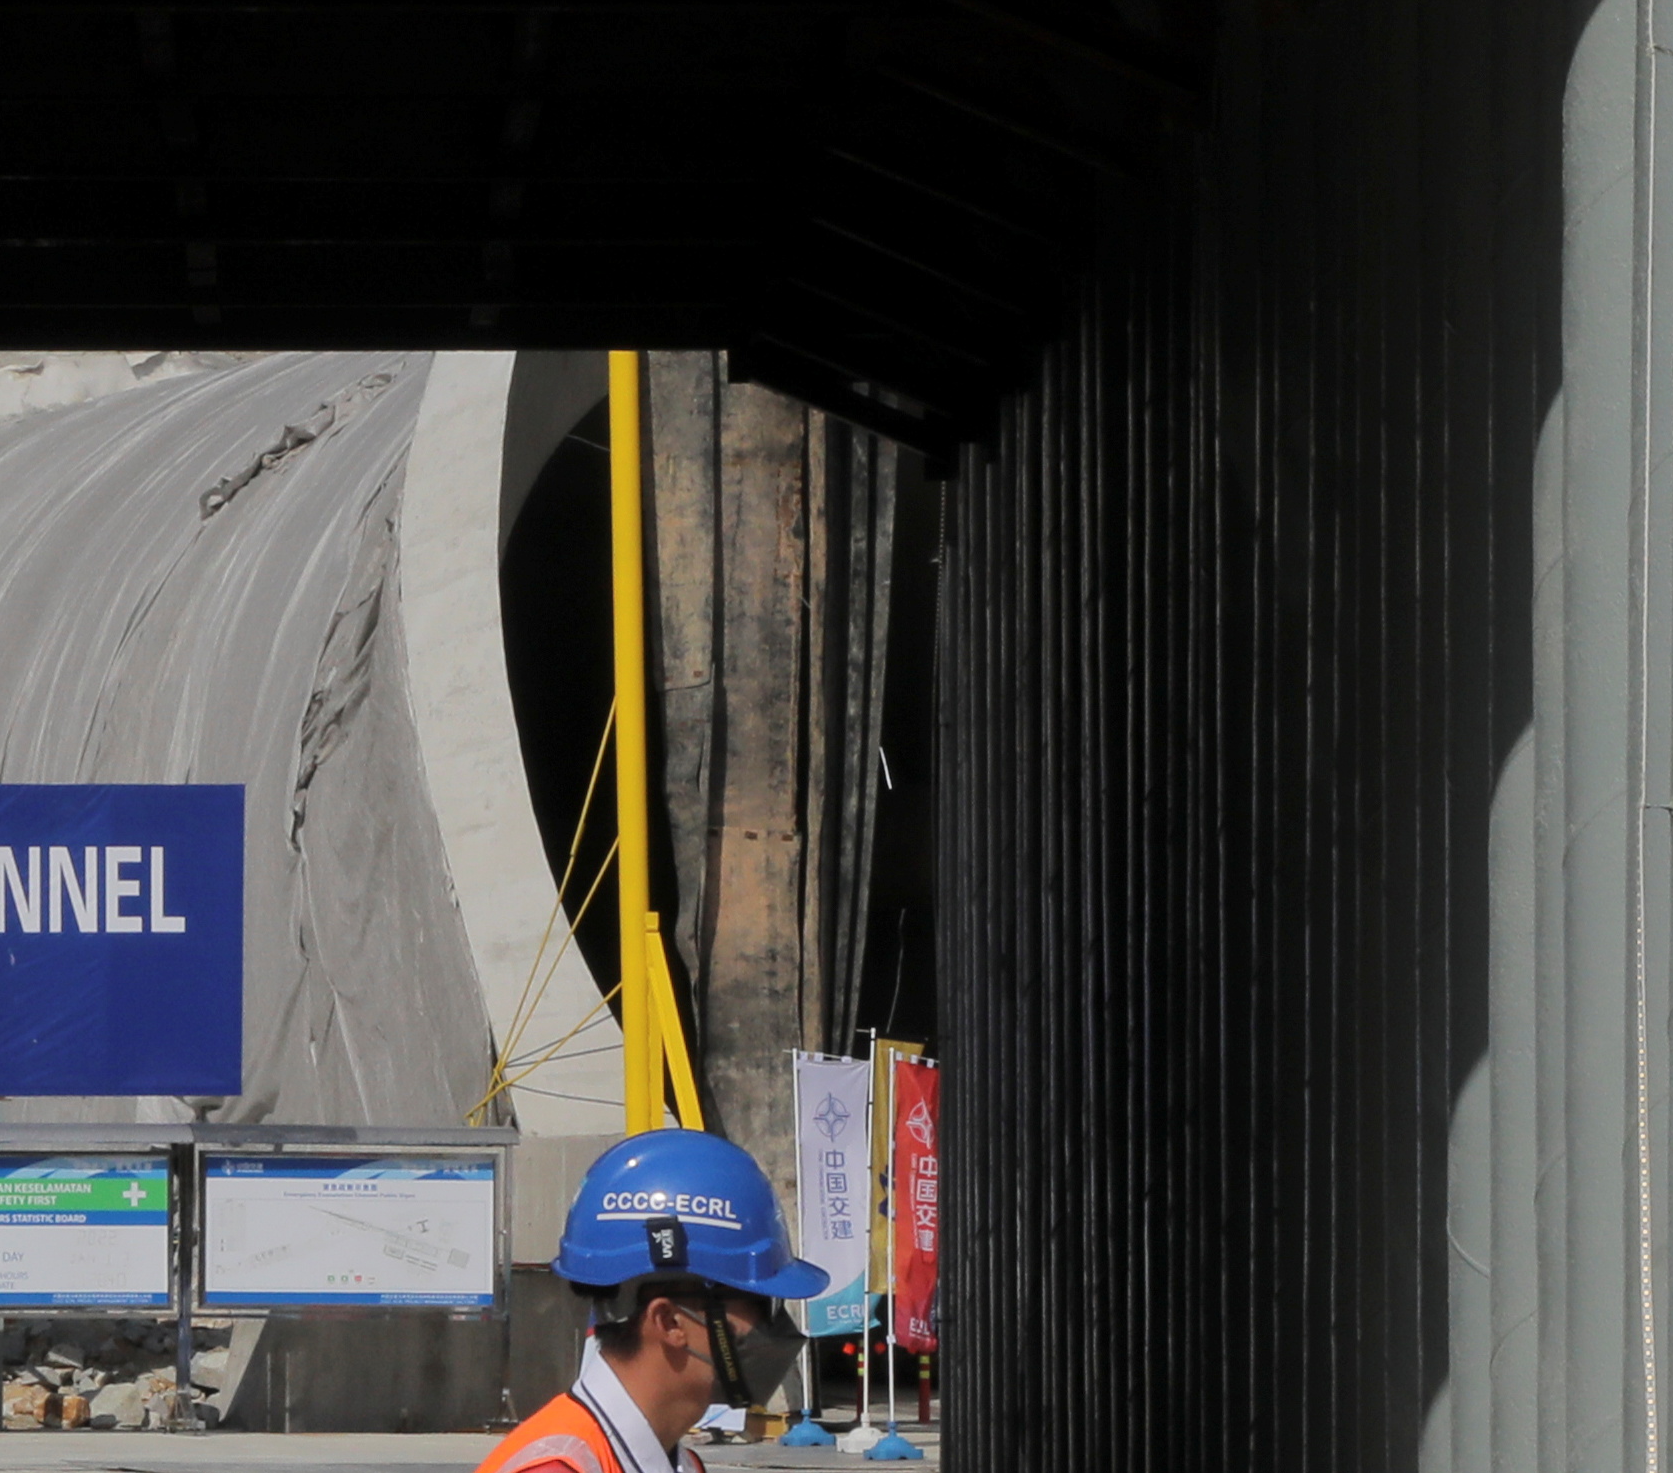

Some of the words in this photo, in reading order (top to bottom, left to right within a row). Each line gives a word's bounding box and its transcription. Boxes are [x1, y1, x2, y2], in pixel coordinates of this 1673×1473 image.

[14, 1183, 91, 1193] KESELAMATAN
[825, 1149, 854, 1240] 中国交建
[27, 1195, 57, 1205] FIRST
[602, 1191, 737, 1219] CCCC-ECRL
[8, 1214, 53, 1223] STATISTIC
[55, 1214, 87, 1223] BOARD
[2, 1252, 24, 1262] DAY
